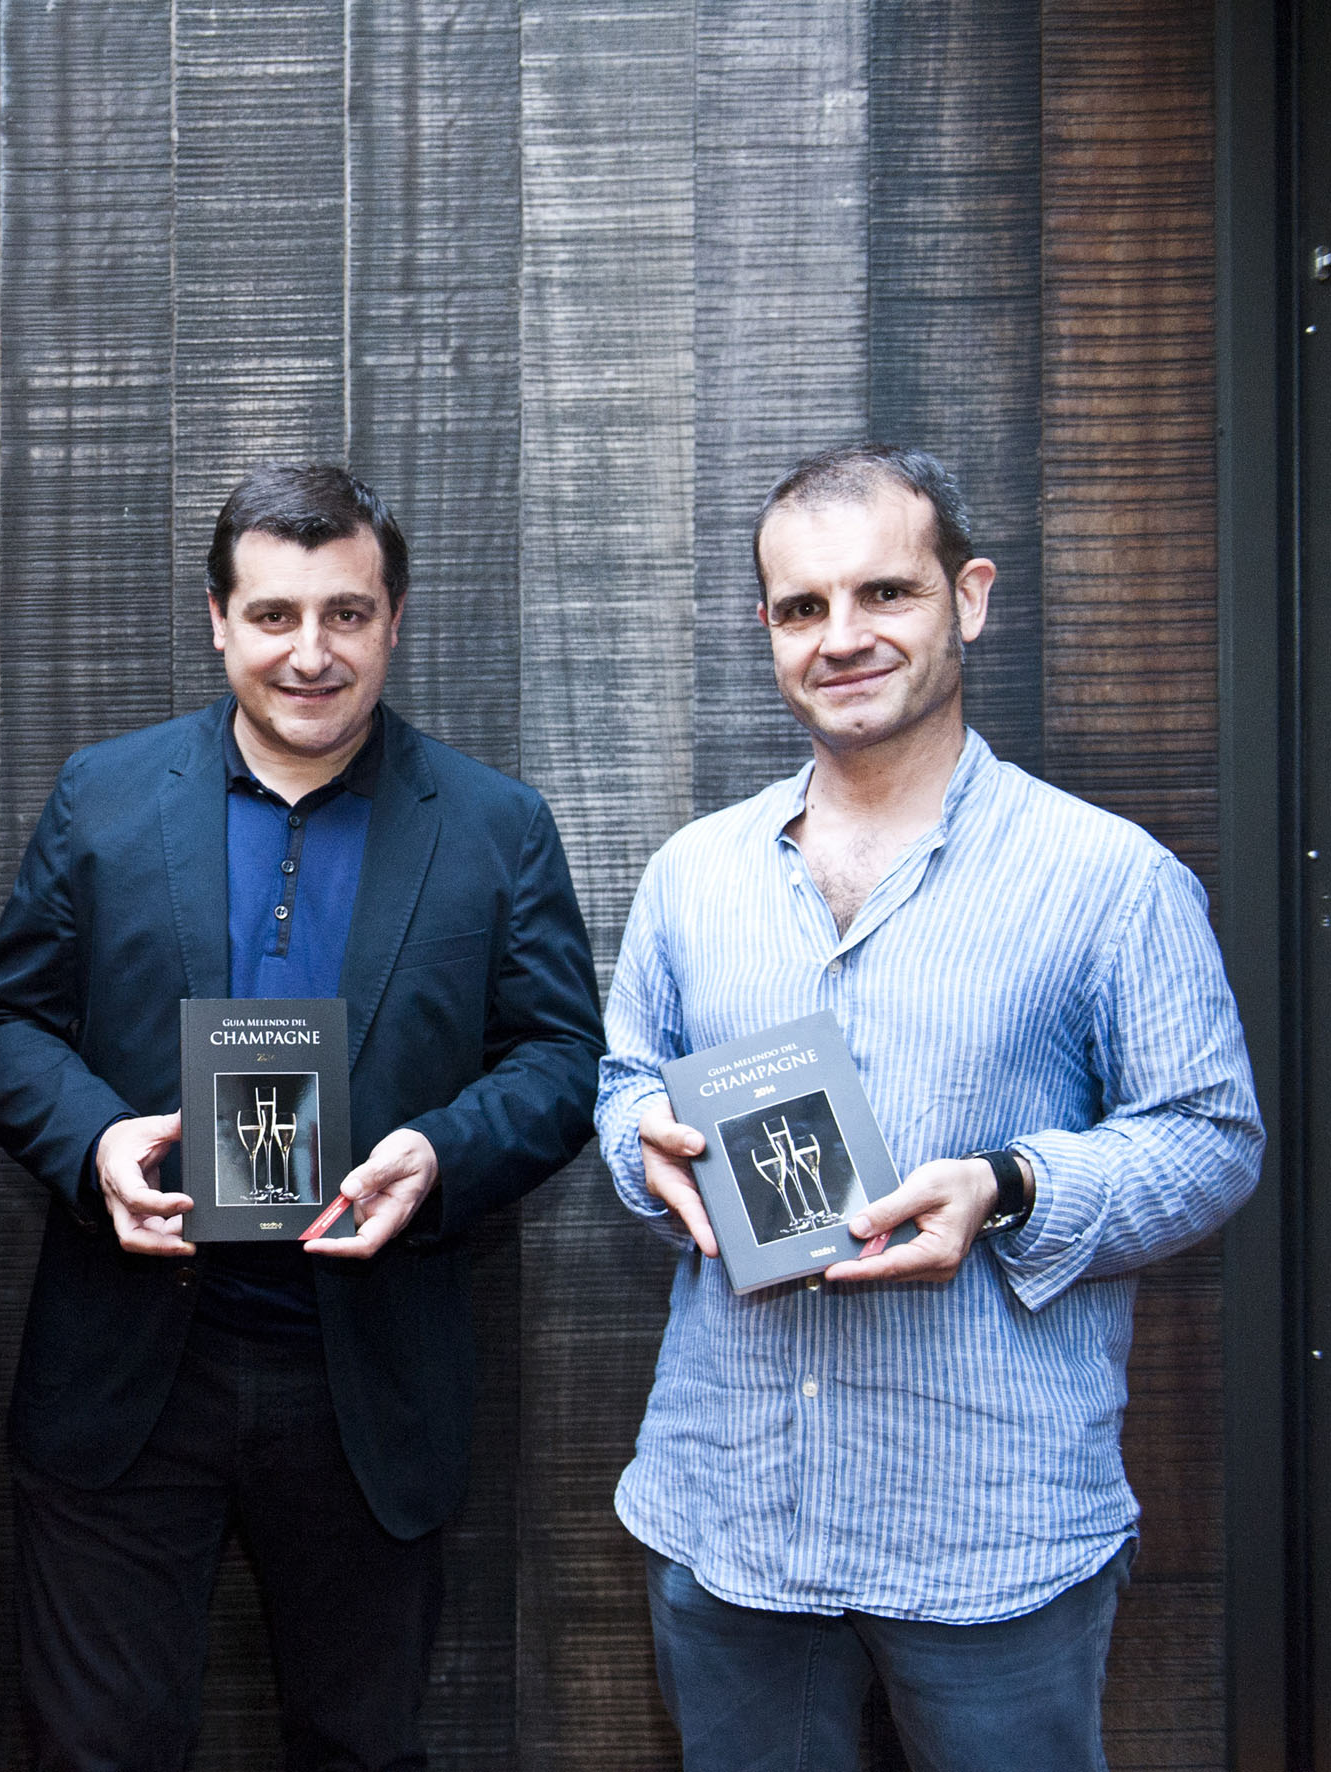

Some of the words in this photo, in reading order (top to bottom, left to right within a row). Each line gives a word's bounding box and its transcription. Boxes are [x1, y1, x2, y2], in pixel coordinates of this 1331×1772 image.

[222, 1018, 245, 1027] GUIA
[247, 1018, 290, 1027] MELENDO
[291, 1019, 307, 1027] DEL
[210, 1031, 321, 1045] CHAMPAGNE
[708, 1065, 732, 1077] GUIA
[733, 1049, 779, 1069] MELENDO
[780, 1043, 798, 1053] DEL
[699, 1049, 818, 1097] CHAMPAGNE
